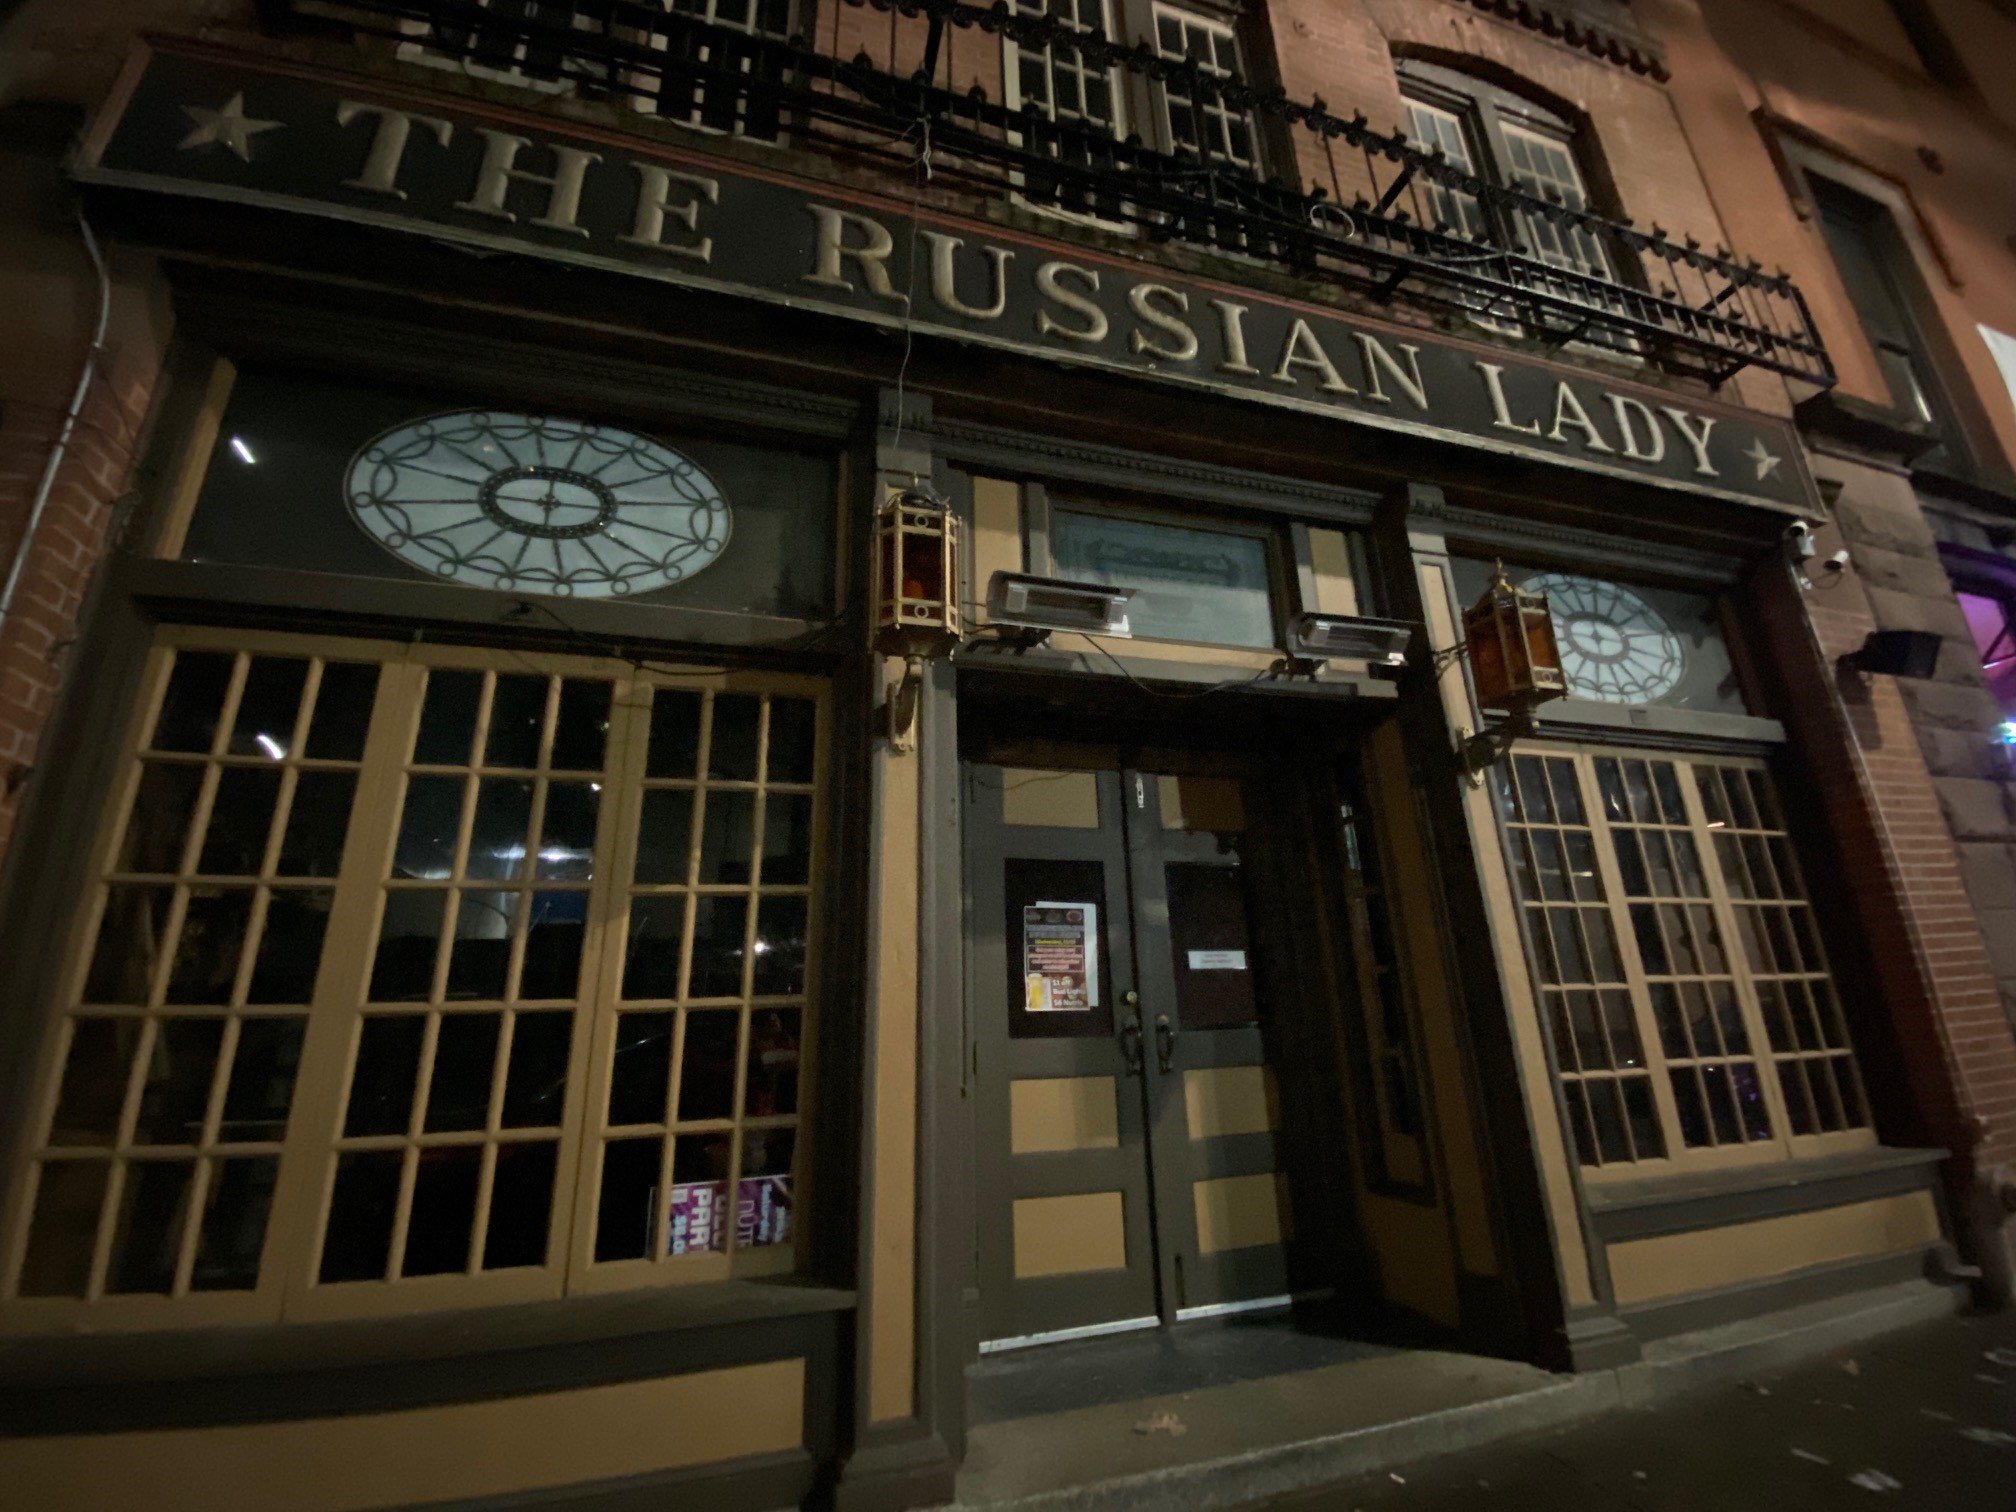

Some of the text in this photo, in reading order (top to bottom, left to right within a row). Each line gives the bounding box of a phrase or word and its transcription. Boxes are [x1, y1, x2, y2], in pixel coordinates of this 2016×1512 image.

[335, 99, 1721, 478] THE RUSSIAN LADY
